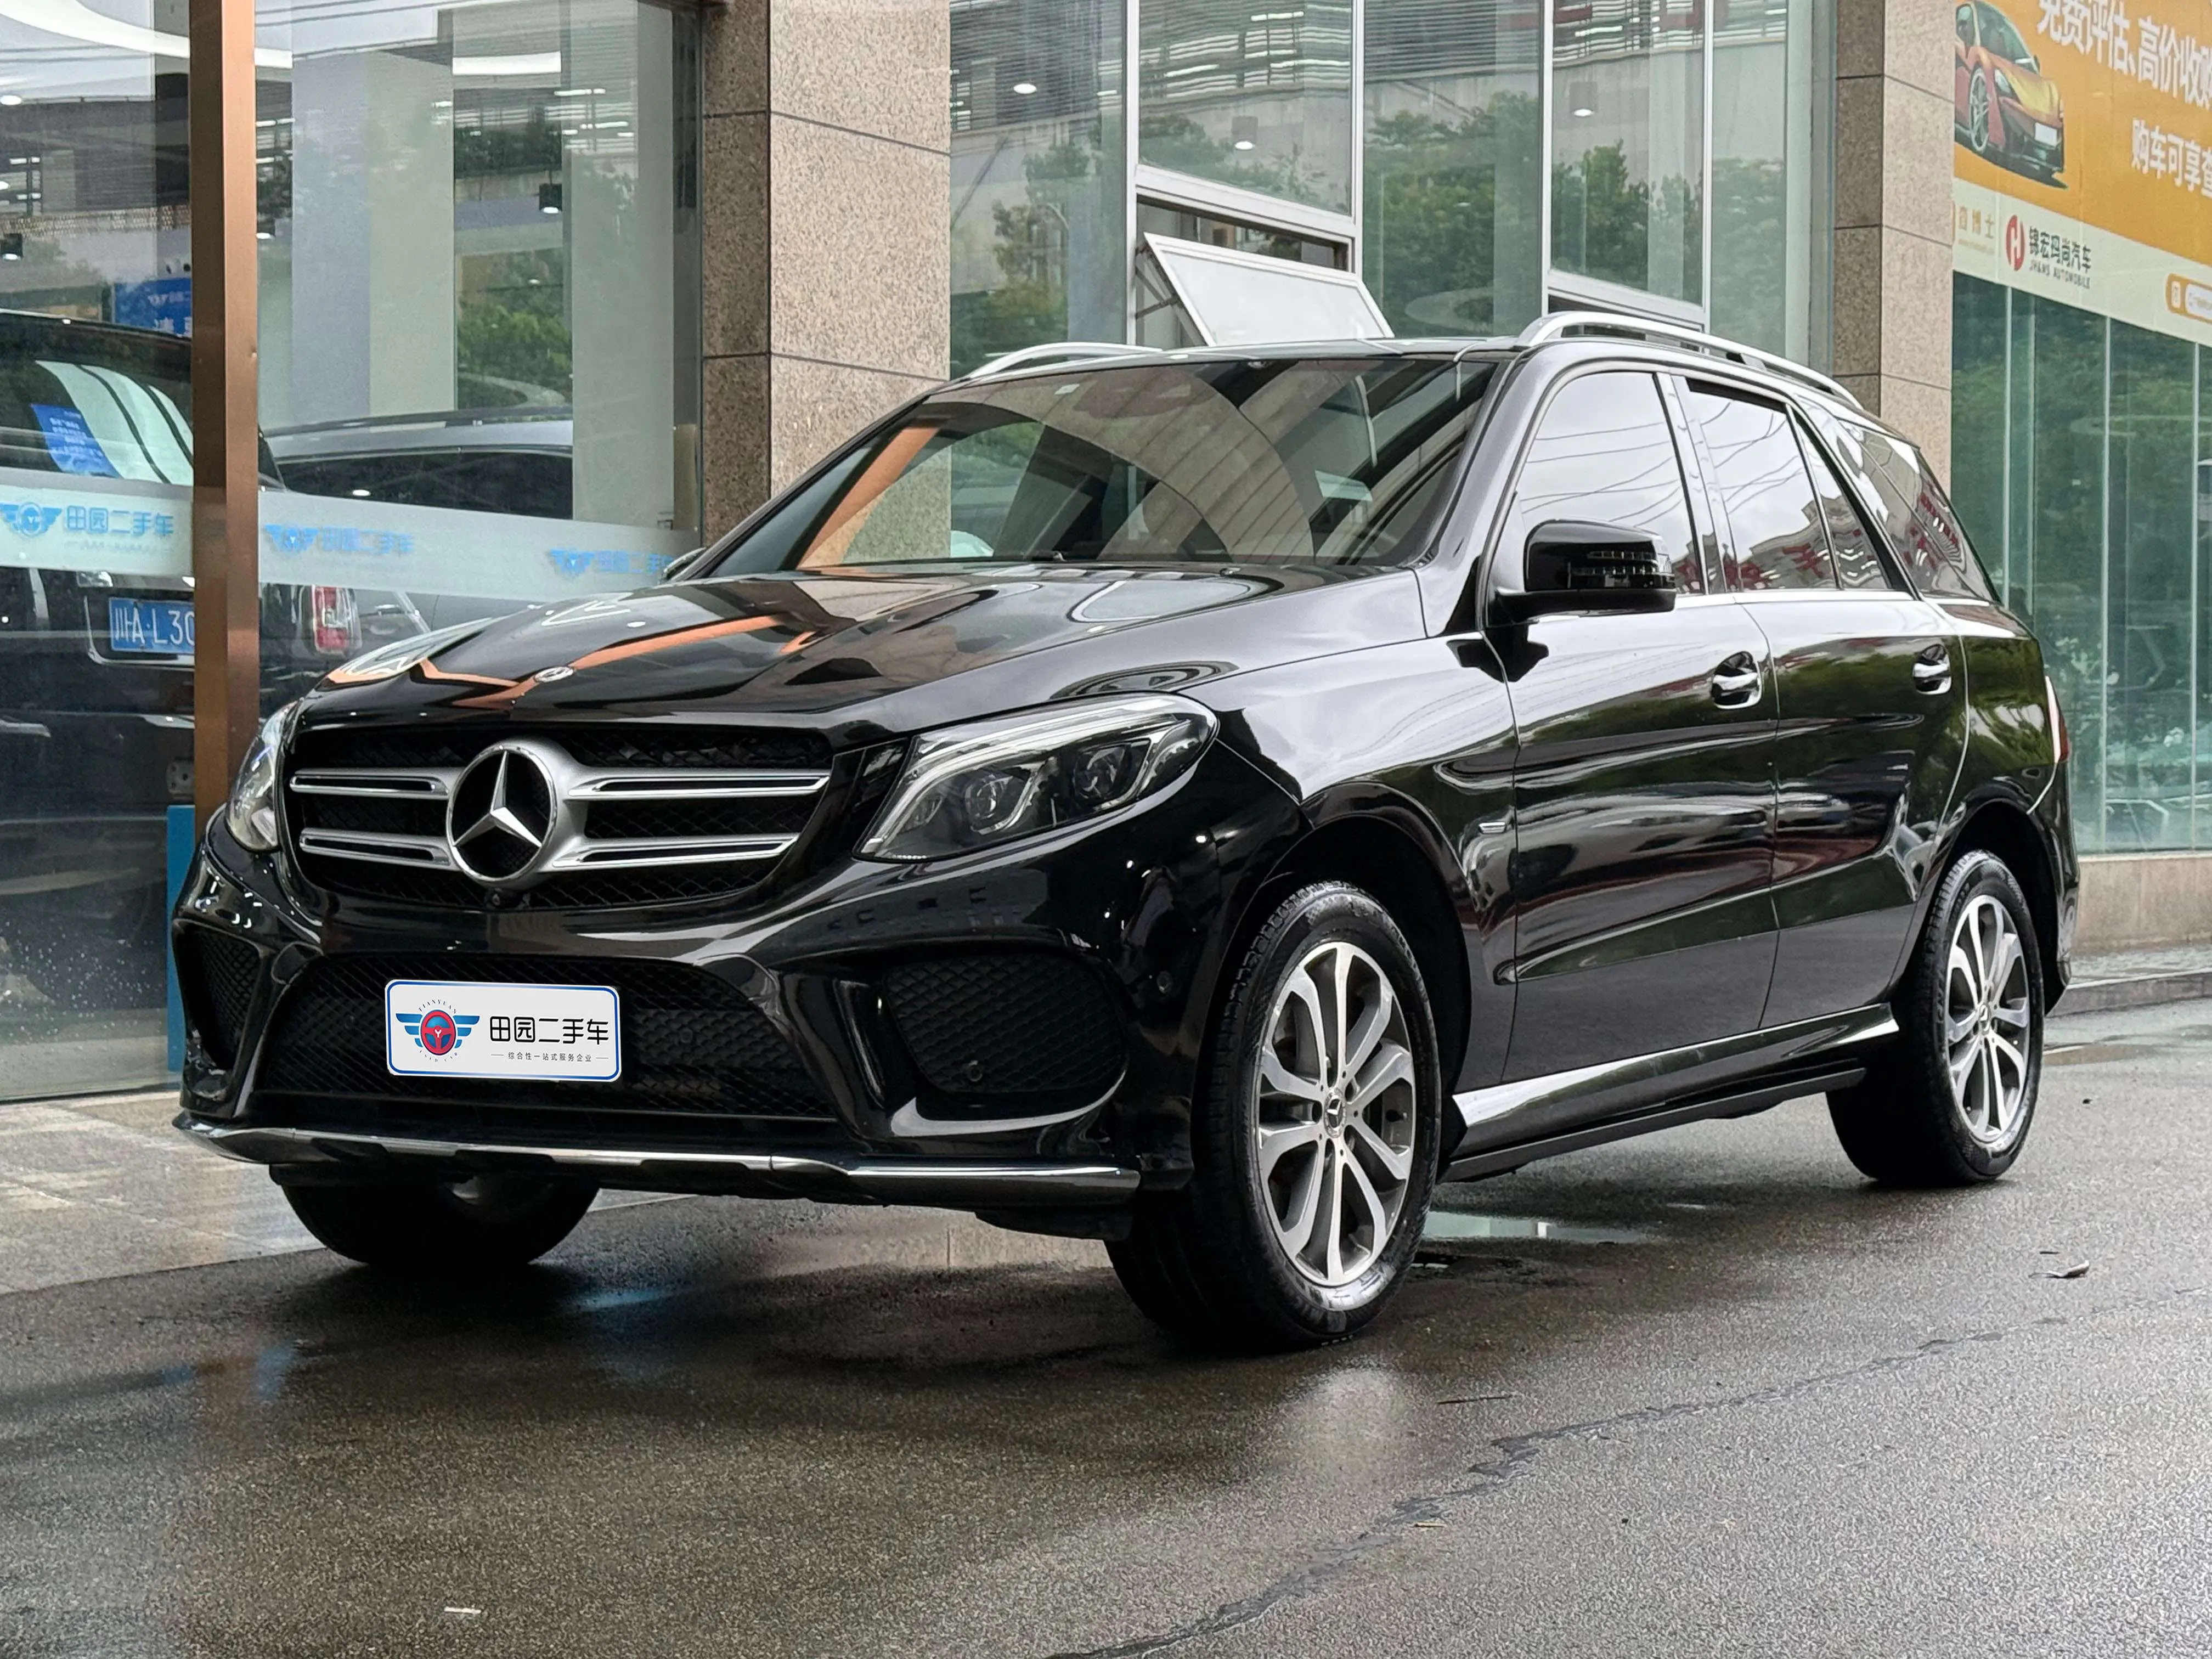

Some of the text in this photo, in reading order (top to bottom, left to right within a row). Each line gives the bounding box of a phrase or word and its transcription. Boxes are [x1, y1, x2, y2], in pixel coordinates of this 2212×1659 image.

[66, 505, 174, 537] 田园二手车
[490, 1016, 609, 1045] 田园二手车
[508, 1051, 591, 1062] 综合性一站式服务企业
